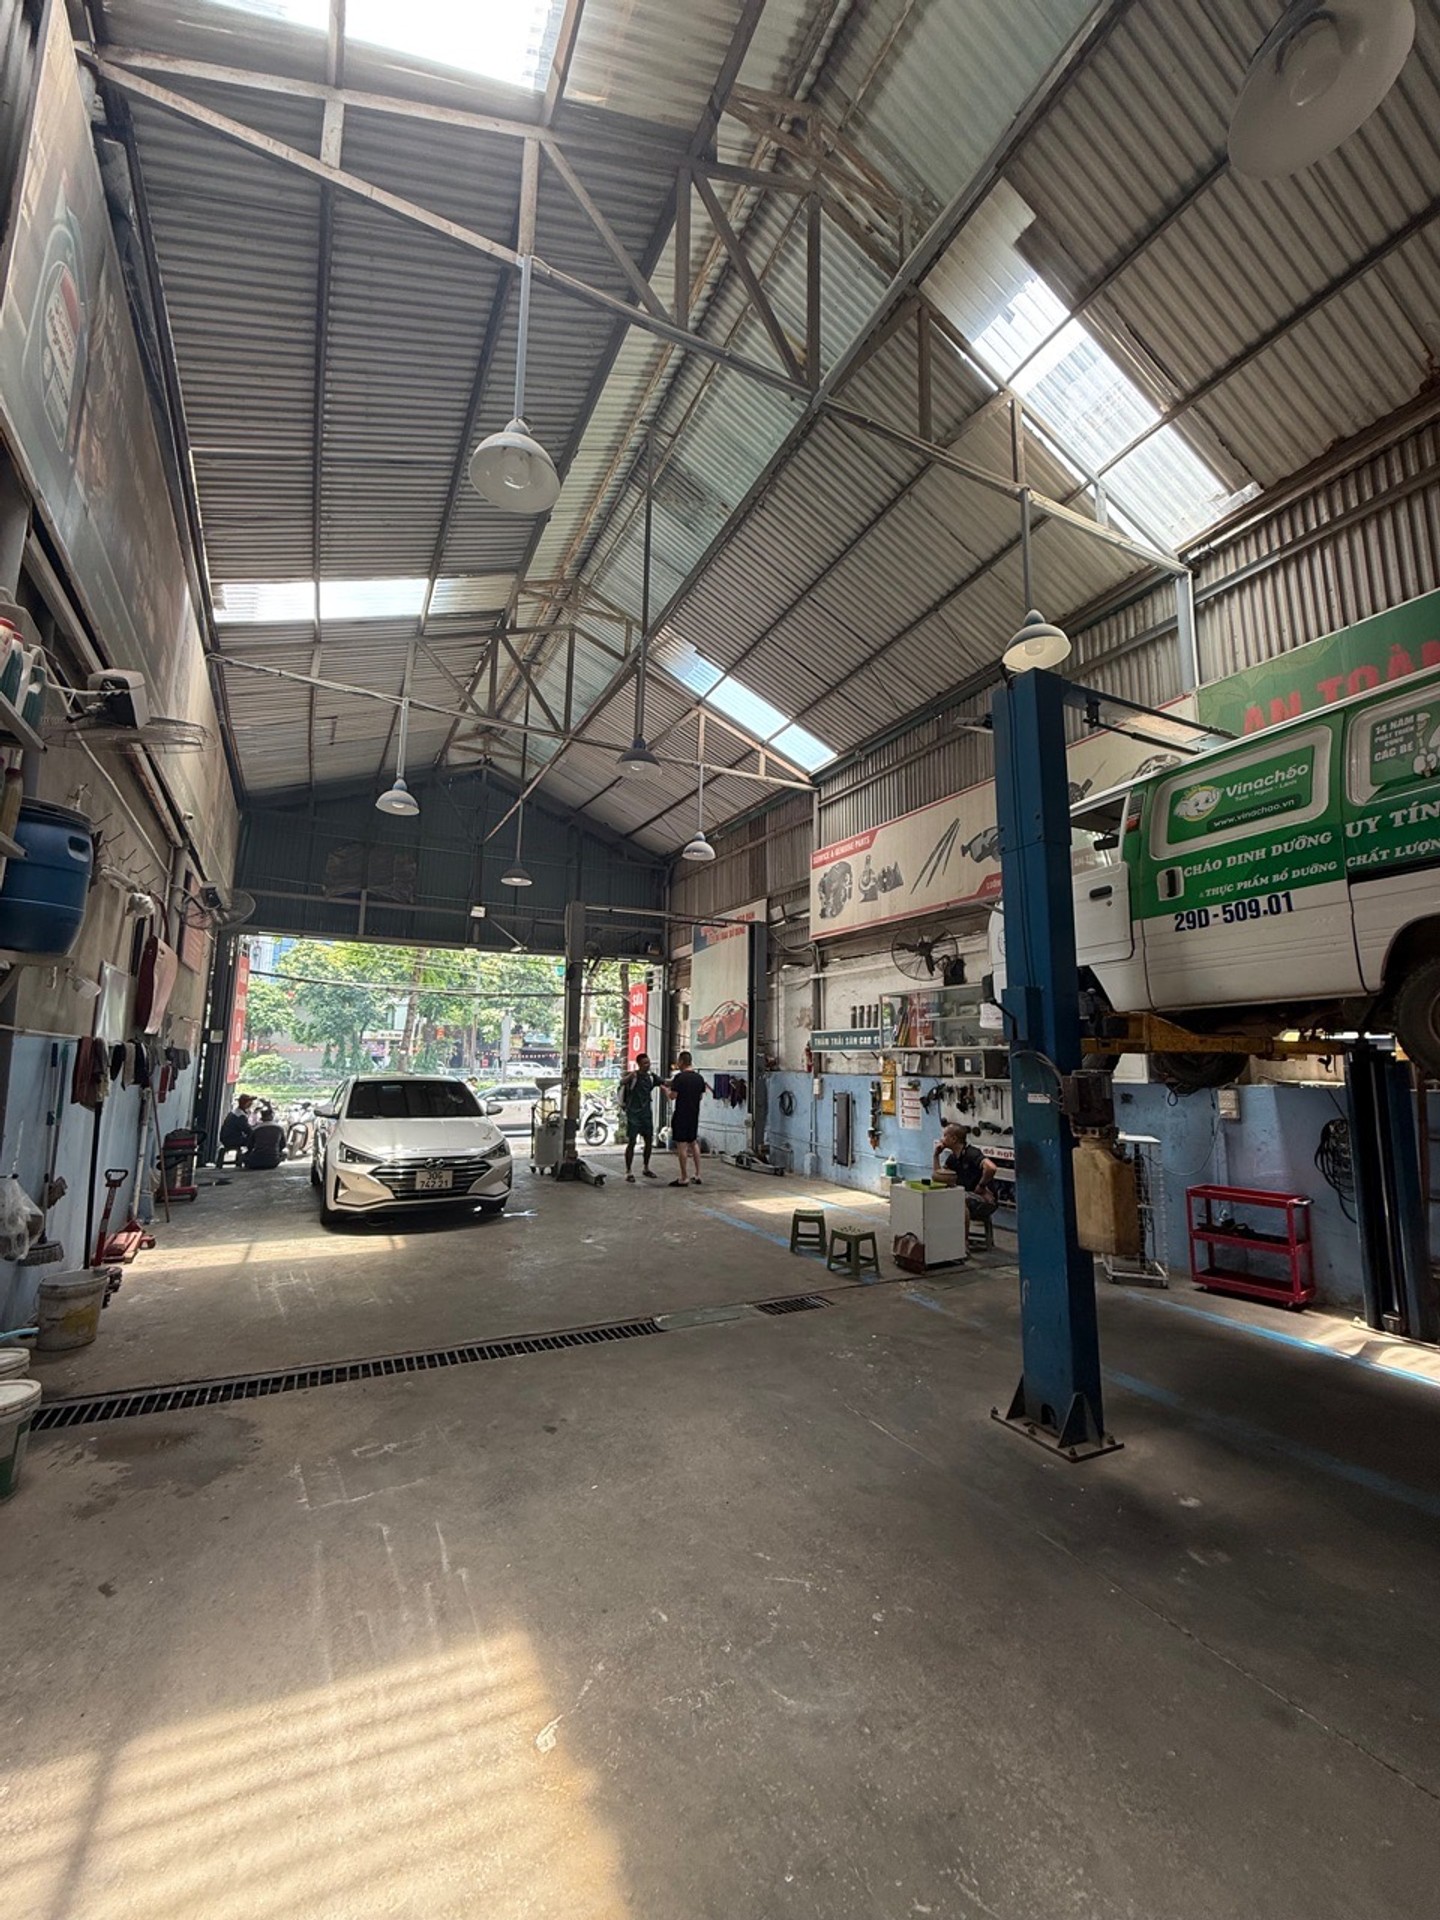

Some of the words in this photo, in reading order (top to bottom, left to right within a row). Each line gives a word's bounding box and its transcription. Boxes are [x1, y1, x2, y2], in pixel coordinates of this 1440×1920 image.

[1213, 799, 1295, 827] www.vinachao.vn
[1345, 815, 1382, 838] UY
[1388, 800, 1440, 828] TÍN
[1183, 858, 1222, 877] CHÁO
[1226, 847, 1267, 867] DINH
[1270, 831, 1333, 857] DƯỠNG
[1346, 846, 1391, 867] CHẤT
[1204, 883, 1234, 897] THỰC
[1291, 860, 1338, 878] DƯỠNG
